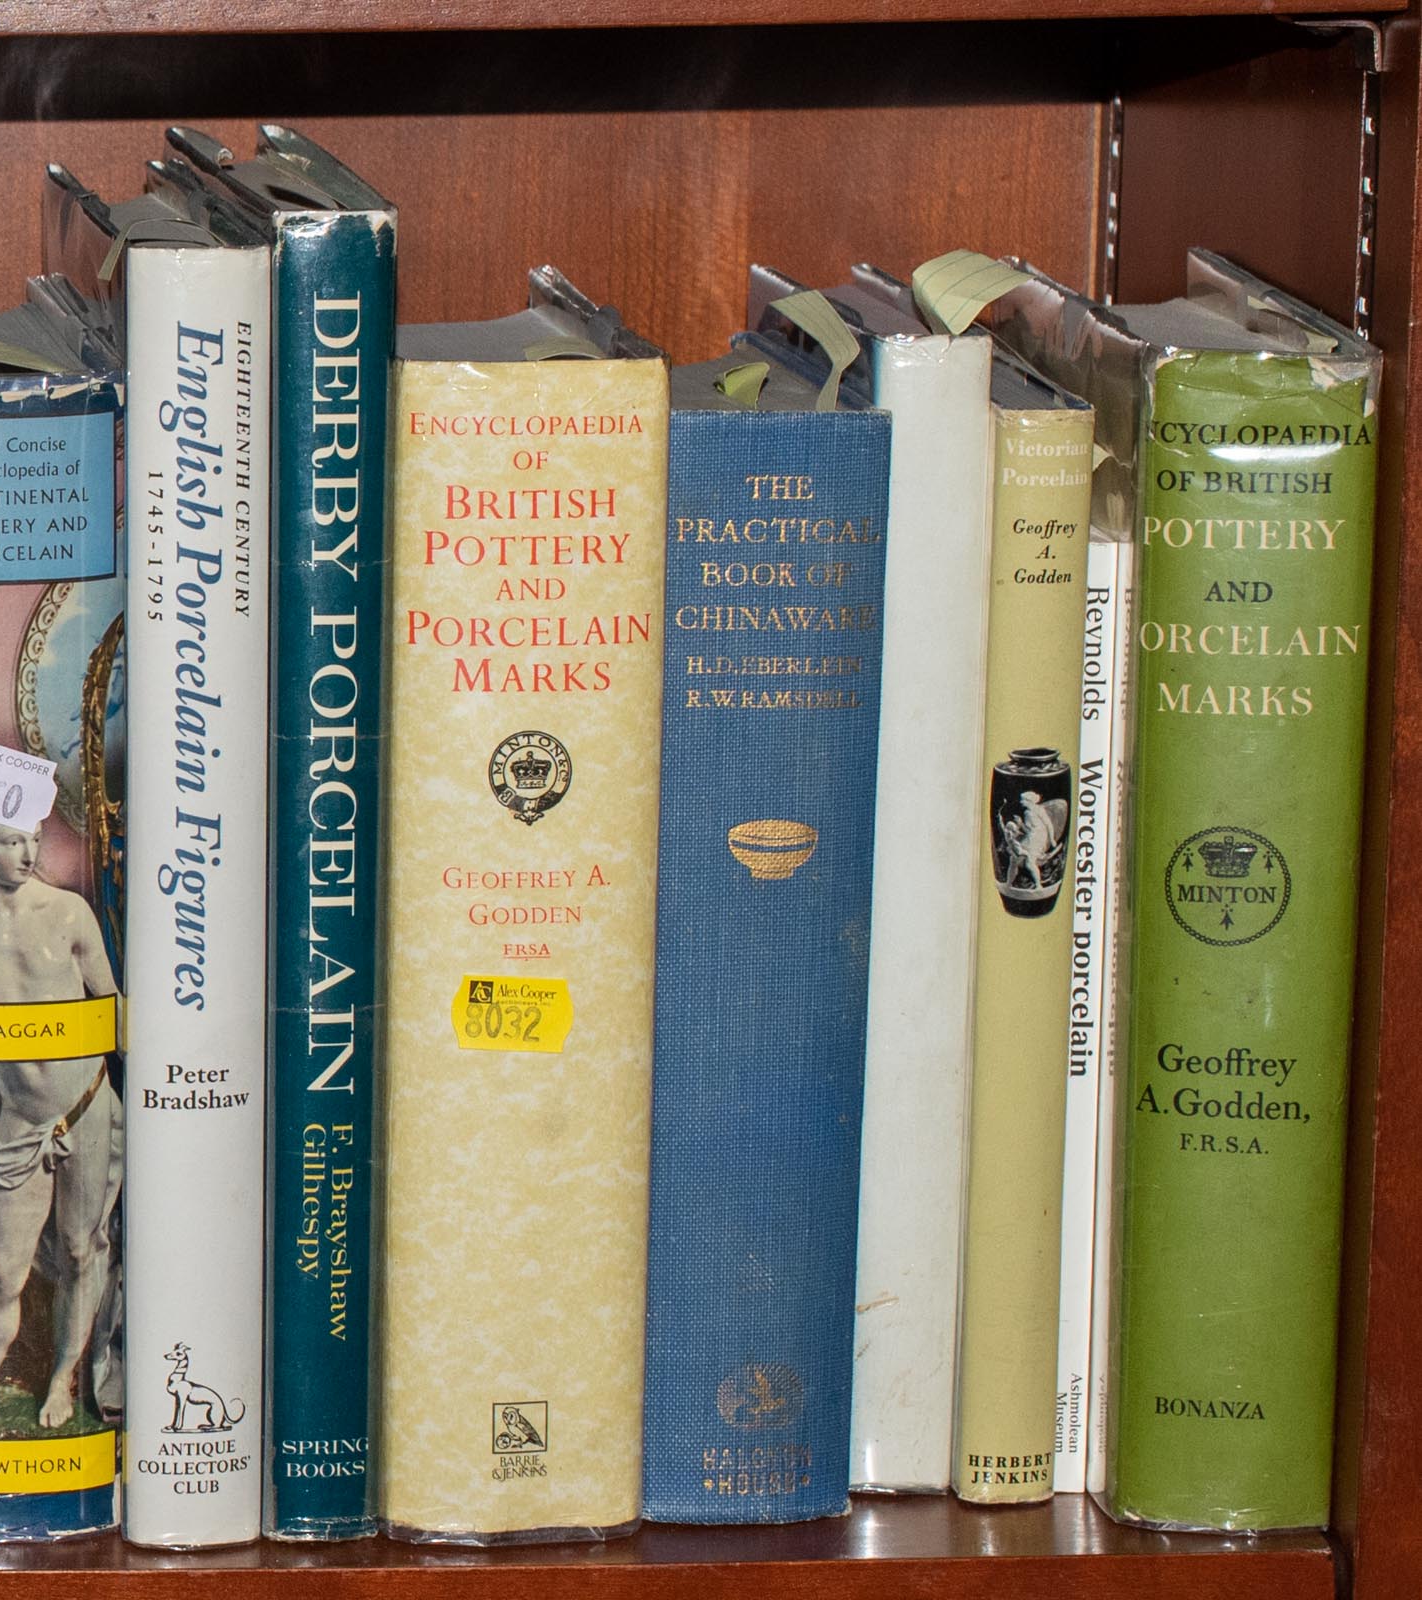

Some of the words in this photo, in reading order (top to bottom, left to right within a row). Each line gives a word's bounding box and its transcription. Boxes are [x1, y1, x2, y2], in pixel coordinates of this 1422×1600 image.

[236, 321, 252, 491] EIGHTEENTH
[158, 321, 224, 531] English
[310, 291, 361, 583] DERBY
[6, 437, 67, 453] Concise
[1203, 472, 1332, 493] BRITISH
[445, 484, 616, 519] BRITISH
[675, 517, 880, 543] PRACTICAL
[1013, 518, 1077, 540] Geoffrey
[1143, 517, 1346, 550] POTTERY
[146, 471, 162, 622] 1745-1795
[234, 501, 251, 616] CENTURY
[424, 531, 630, 565] POTTERY
[701, 563, 796, 586] BOOK
[1014, 568, 1072, 585] Godden
[407, 610, 651, 645] PORCELAIN
[675, 606, 875, 630] CHINAWARE
[175, 541, 223, 794] Porcelain
[452, 658, 612, 693] MARKS
[1158, 682, 1313, 716] MARKS
[6, 756, 49, 776] COOPER
[308, 606, 358, 1095] PORCELAIN
[1078, 759, 1104, 920] Worcester
[159, 807, 223, 1011] Figures
[1178, 884, 1277, 903] MINTON
[1070, 931, 1095, 1077] porcelain
[166, 1064, 229, 1084] Peter
[1157, 1044, 1297, 1087] Geoffrey
[142, 1088, 250, 1110] Bradshaw
[1136, 1085, 1168, 1114] A.
[1174, 1087, 1311, 1123] Godden,
[329, 1123, 353, 1152] F.
[296, 1123, 325, 1279] Gilhespy
[328, 1163, 353, 1340] Brayshaw
[1155, 1398, 1265, 1420] BONANZA
[968, 1454, 1052, 1468] HERBERT
[971, 1469, 1048, 1484] JENKINS
